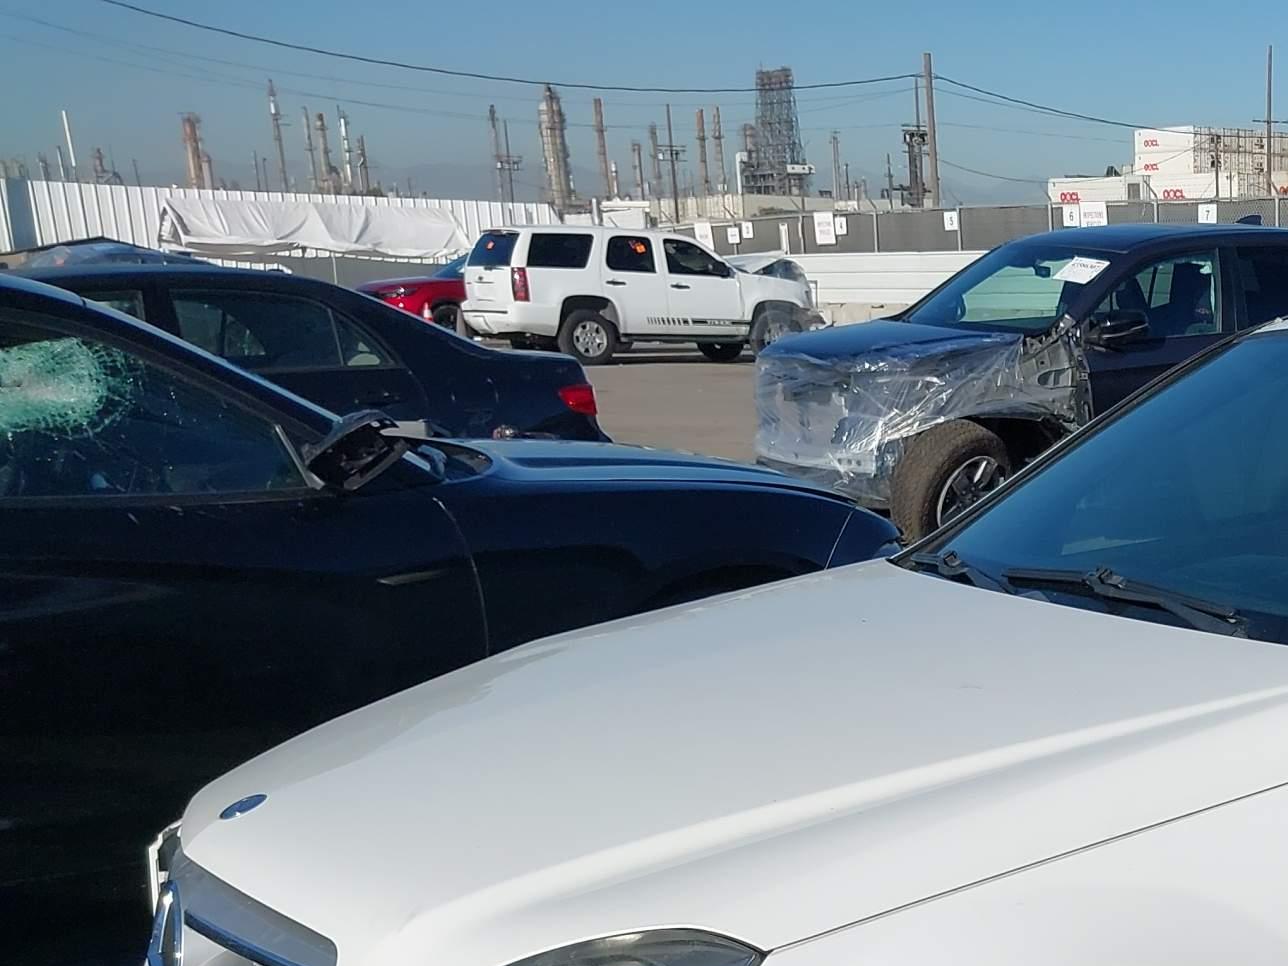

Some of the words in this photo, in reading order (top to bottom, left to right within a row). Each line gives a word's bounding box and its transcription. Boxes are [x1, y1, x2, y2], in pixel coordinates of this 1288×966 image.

[1143, 139, 1160, 147] OOCL
[1143, 163, 1159, 171] OOCL
[1060, 191, 1081, 202] OOCL
[1162, 189, 1186, 199] OOCL
[1069, 211, 1074, 222] 6
[1204, 210, 1211, 220] 7
